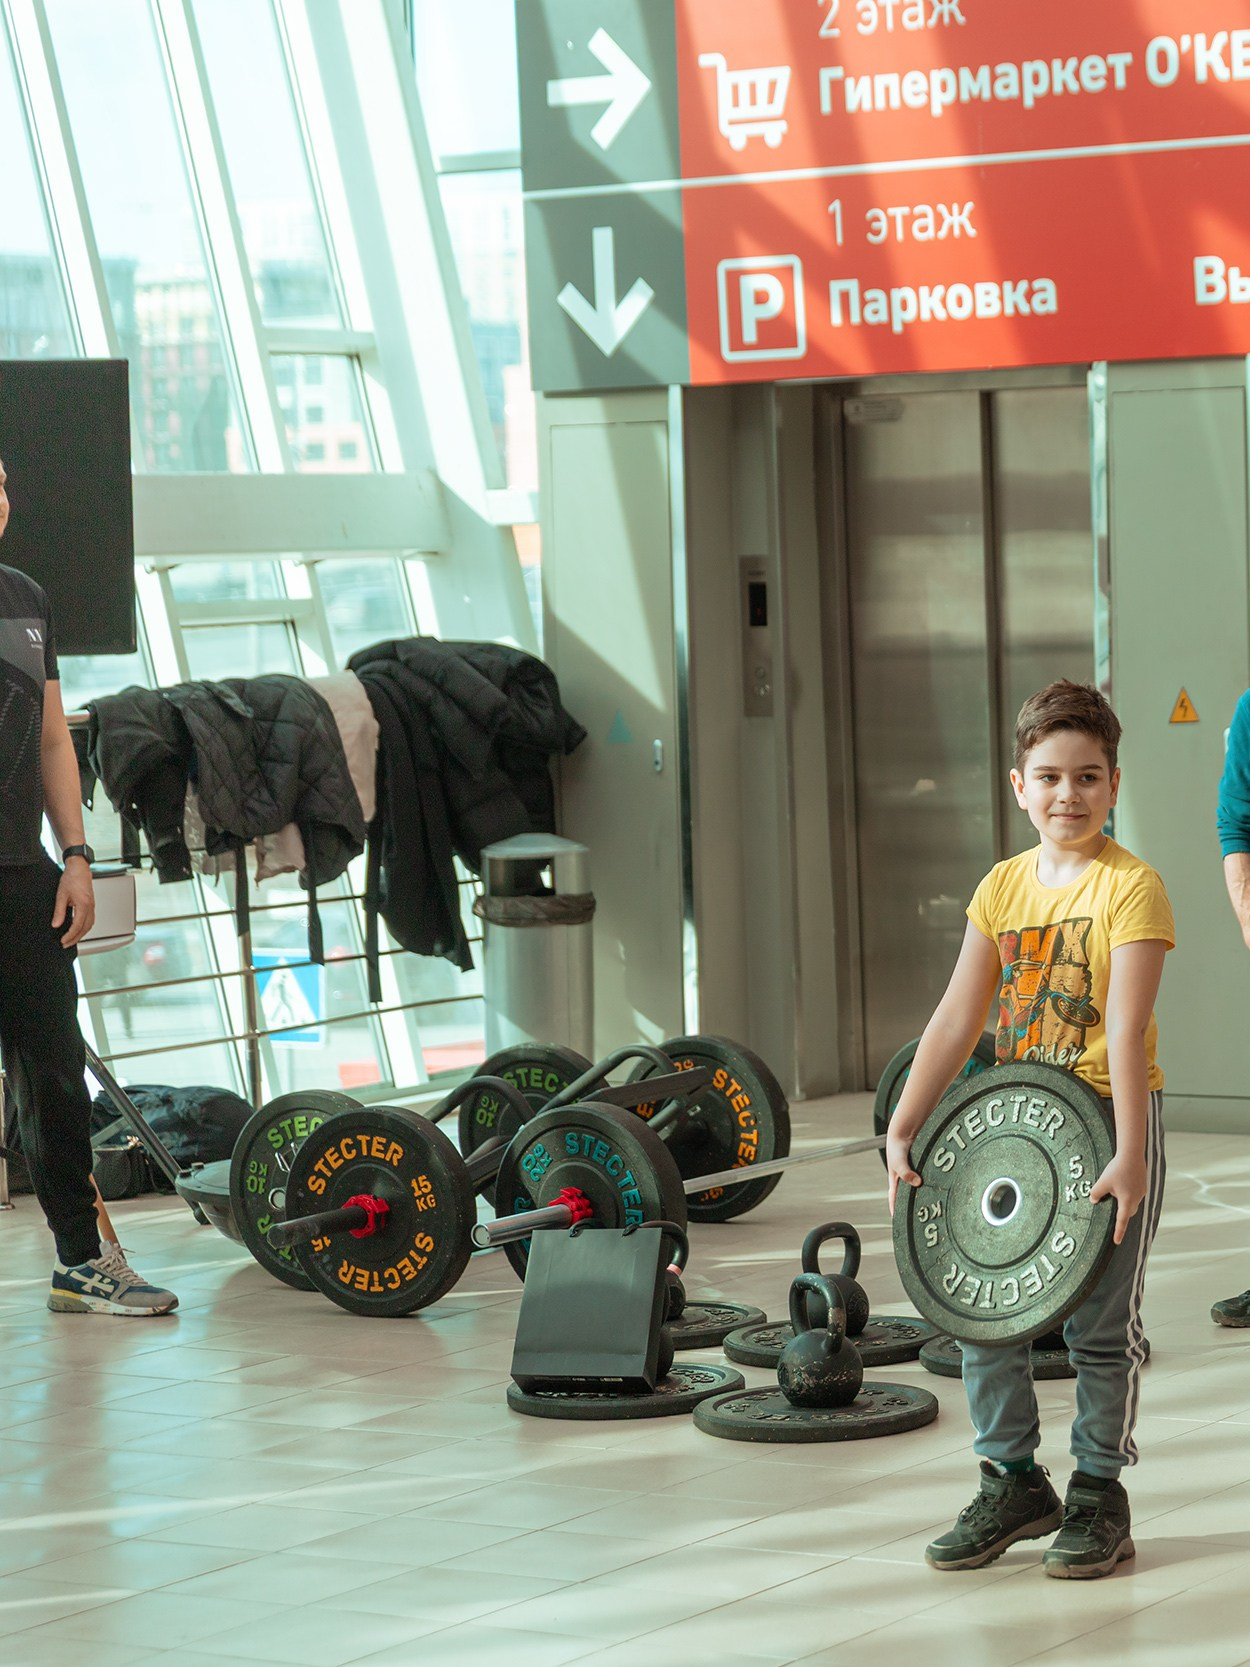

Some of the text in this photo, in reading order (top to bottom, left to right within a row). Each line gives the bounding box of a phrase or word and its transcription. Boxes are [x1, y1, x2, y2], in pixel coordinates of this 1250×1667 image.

[818, 0, 967, 38] 2 этаж
[819, 52, 1133, 117] Гипермаркет
[828, 199, 977, 246] 1 этаж
[829, 277, 1058, 334] Парковка
[998, 917, 1092, 968] BMX
[933, 1095, 1065, 1172] STECTER
[249, 1160, 268, 1176] KG
[307, 1134, 404, 1195] STECTER
[521, 1153, 546, 1182] 20
[533, 1143, 553, 1167] KG
[1069, 1155, 1084, 1179] 5
[246, 1175, 266, 1195] 10
[410, 1174, 432, 1197] 15
[1065, 1180, 1092, 1202] KG
[415, 1193, 437, 1212] KG
[917, 1200, 942, 1223] KG
[924, 1223, 939, 1248] 5
[338, 1232, 434, 1292] STECTER
[943, 1231, 1077, 1309] STECTER
